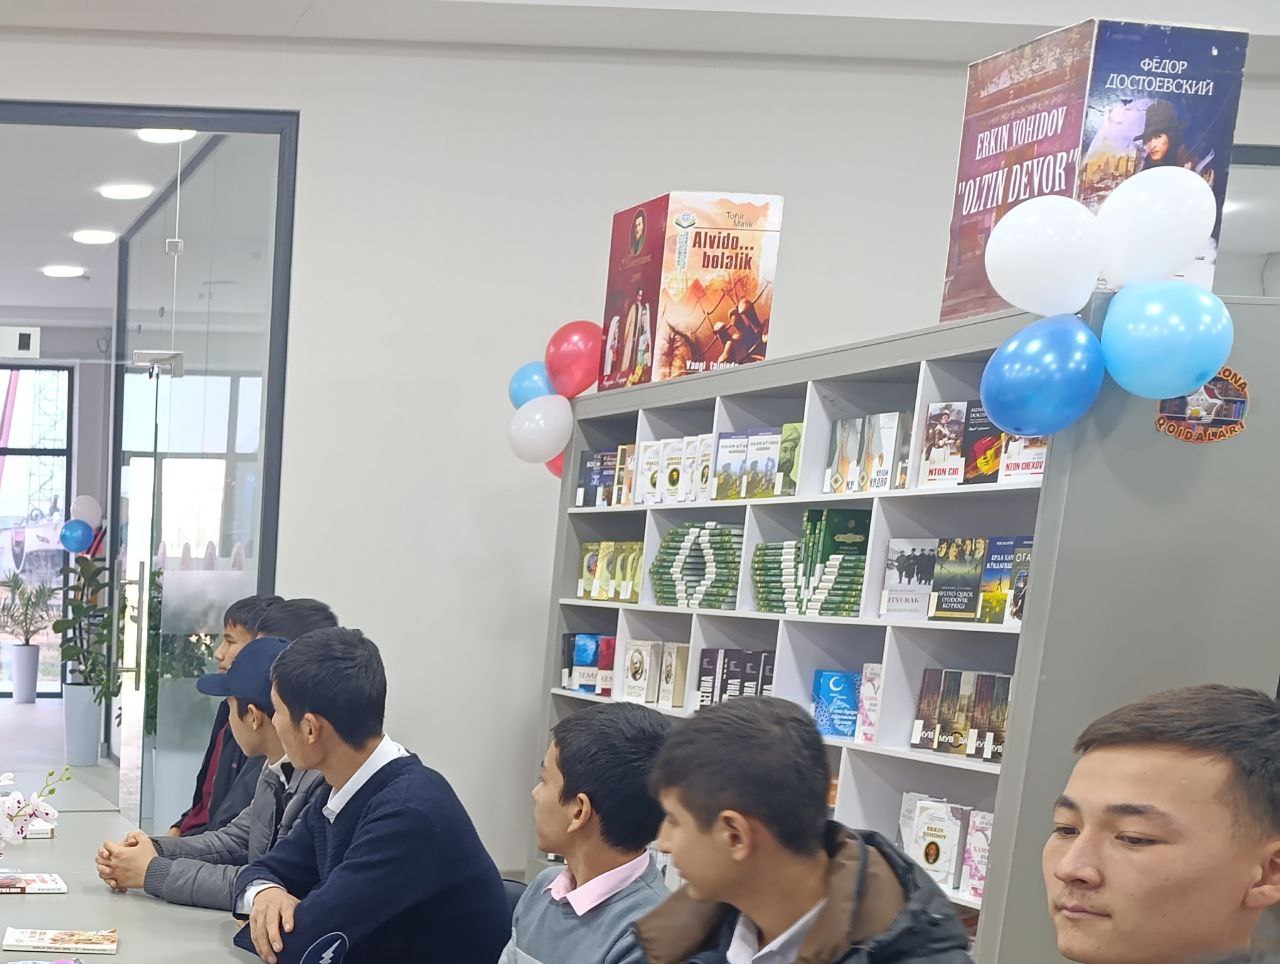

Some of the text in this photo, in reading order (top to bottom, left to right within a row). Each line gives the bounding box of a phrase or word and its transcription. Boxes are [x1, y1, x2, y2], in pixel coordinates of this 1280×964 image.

[1140, 55, 1188, 74] ФЁДОР
[1105, 73, 1214, 96] ДОСТОЕВСКИЙ
[975, 106, 1067, 160] ERKIN VOHIDOV
[701, 251, 753, 270] bolalik
[1218, 367, 1248, 392] ONA
[928, 467, 946, 476] NTON
[1005, 463, 1020, 472] NTON
